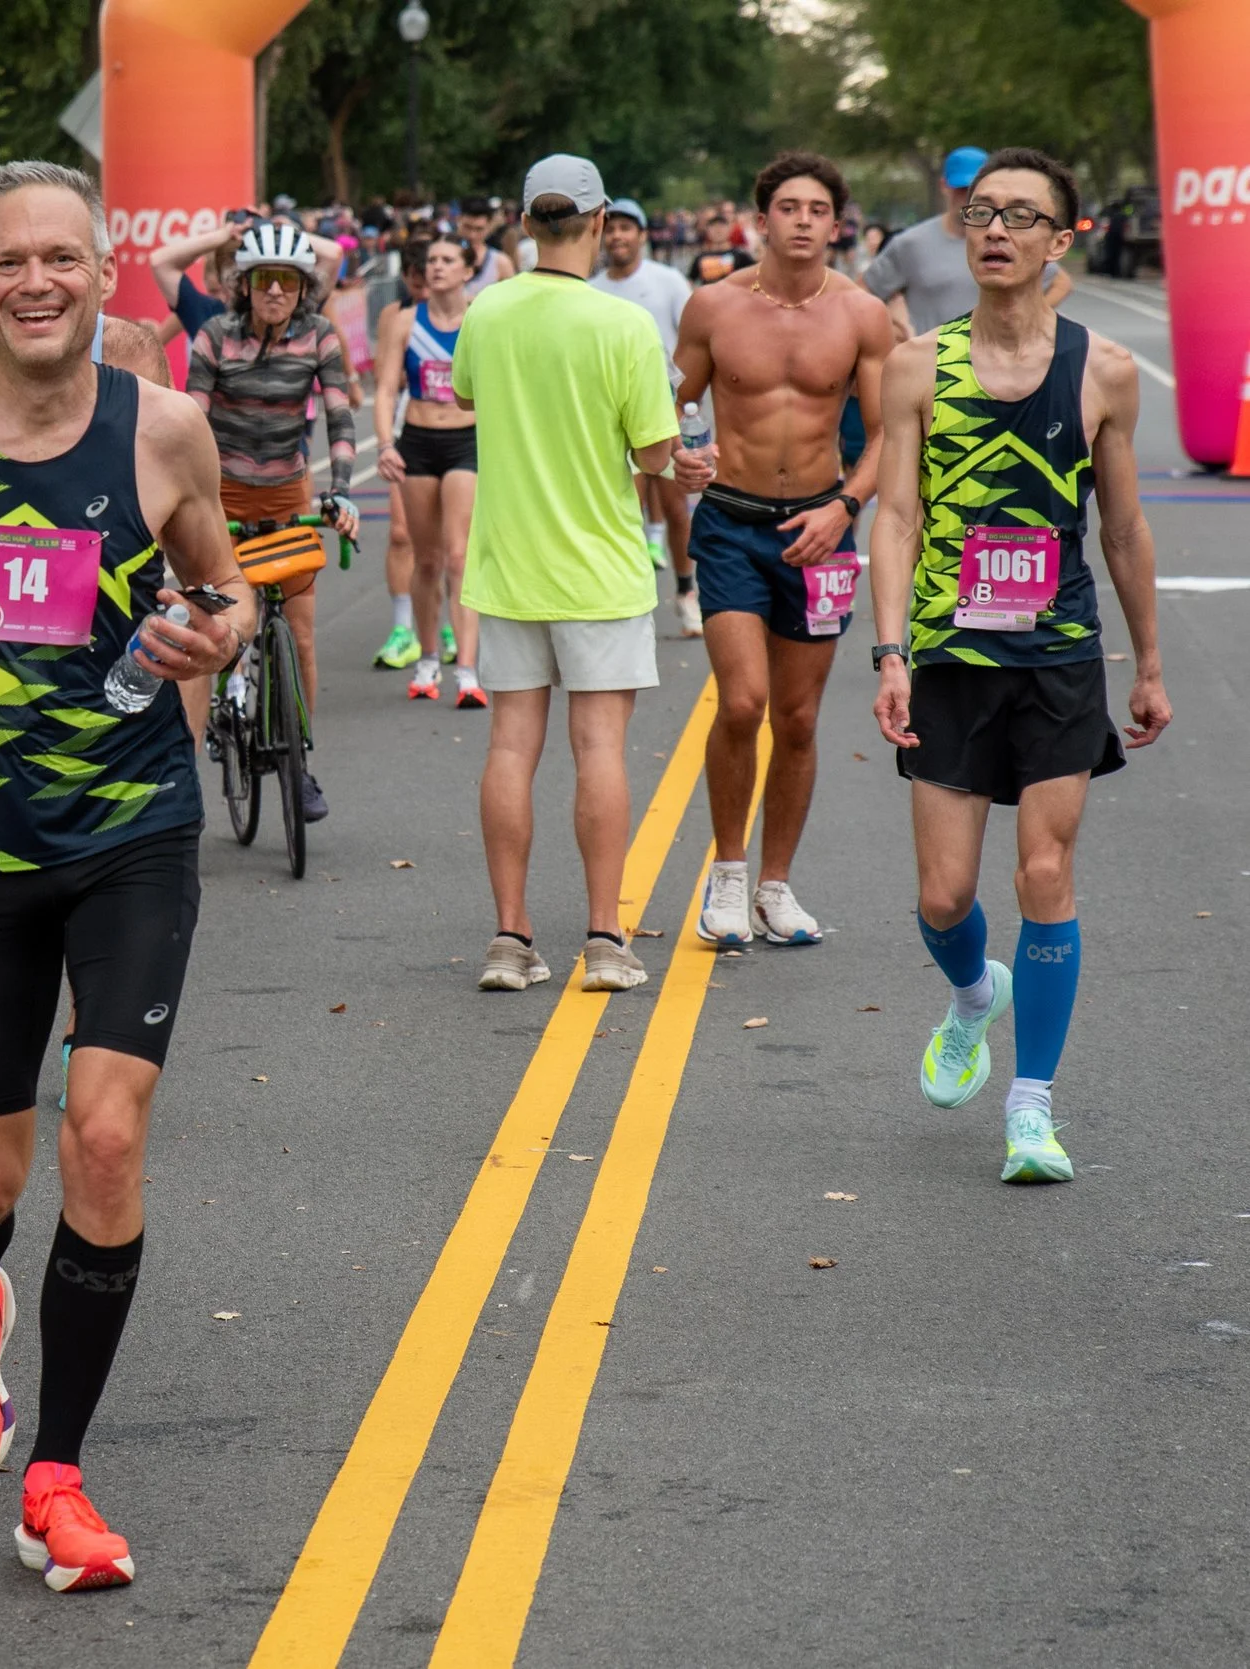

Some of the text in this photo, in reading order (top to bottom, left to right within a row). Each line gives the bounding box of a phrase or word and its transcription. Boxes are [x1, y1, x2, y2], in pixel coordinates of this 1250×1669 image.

[111, 208, 228, 247] pace
[3, 557, 49, 603] 14
[974, 549, 1046, 583] 1061
[976, 583, 992, 602] B
